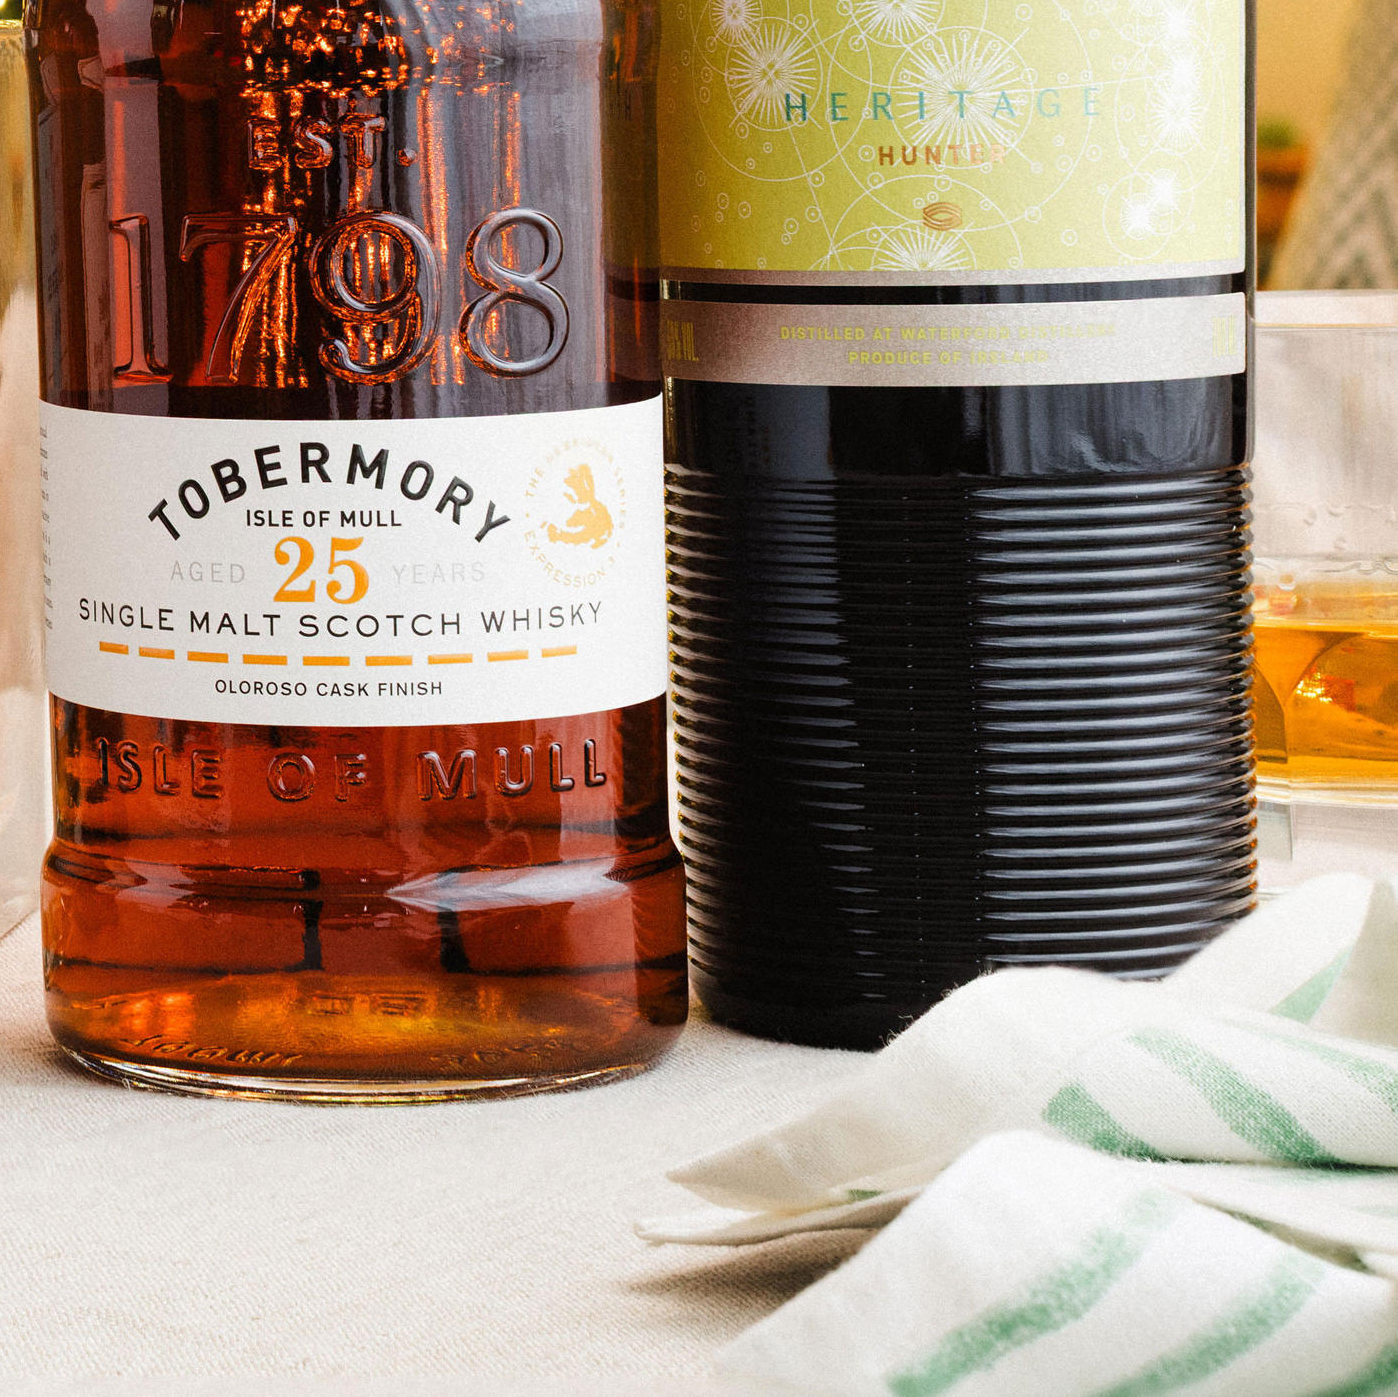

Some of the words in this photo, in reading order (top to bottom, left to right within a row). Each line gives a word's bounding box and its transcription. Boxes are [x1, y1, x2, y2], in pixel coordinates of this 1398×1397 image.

[784, 86, 1101, 122] HERITAGE
[245, 113, 417, 170] EST.
[878, 143, 1007, 167] HUNTER
[108, 208, 572, 387] 1798
[780, 325, 865, 342] DISTILLED
[873, 326, 892, 341] AT
[901, 325, 1010, 341] WATERFORD
[848, 350, 932, 365] PRODUCE
[939, 350, 962, 365] OF
[148, 441, 511, 543] TOBERMORY
[246, 510, 294, 528] ISLE
[303, 510, 331, 527] OF
[340, 510, 402, 527] MULL
[170, 559, 246, 584] AGED
[273, 535, 370, 605] 25
[392, 561, 485, 584] YEARS
[79, 597, 174, 632] SINGLE
[190, 610, 281, 637] MALT
[298, 612, 461, 638] SCOTCH
[481, 599, 603, 634] WHISKY
[215, 679, 307, 697] OLOROSO
[316, 682, 369, 697] CASK
[378, 680, 443, 697] FINISH
[97, 735, 224, 800] ISLE
[267, 751, 368, 802] OF
[416, 738, 608, 802] MULL
